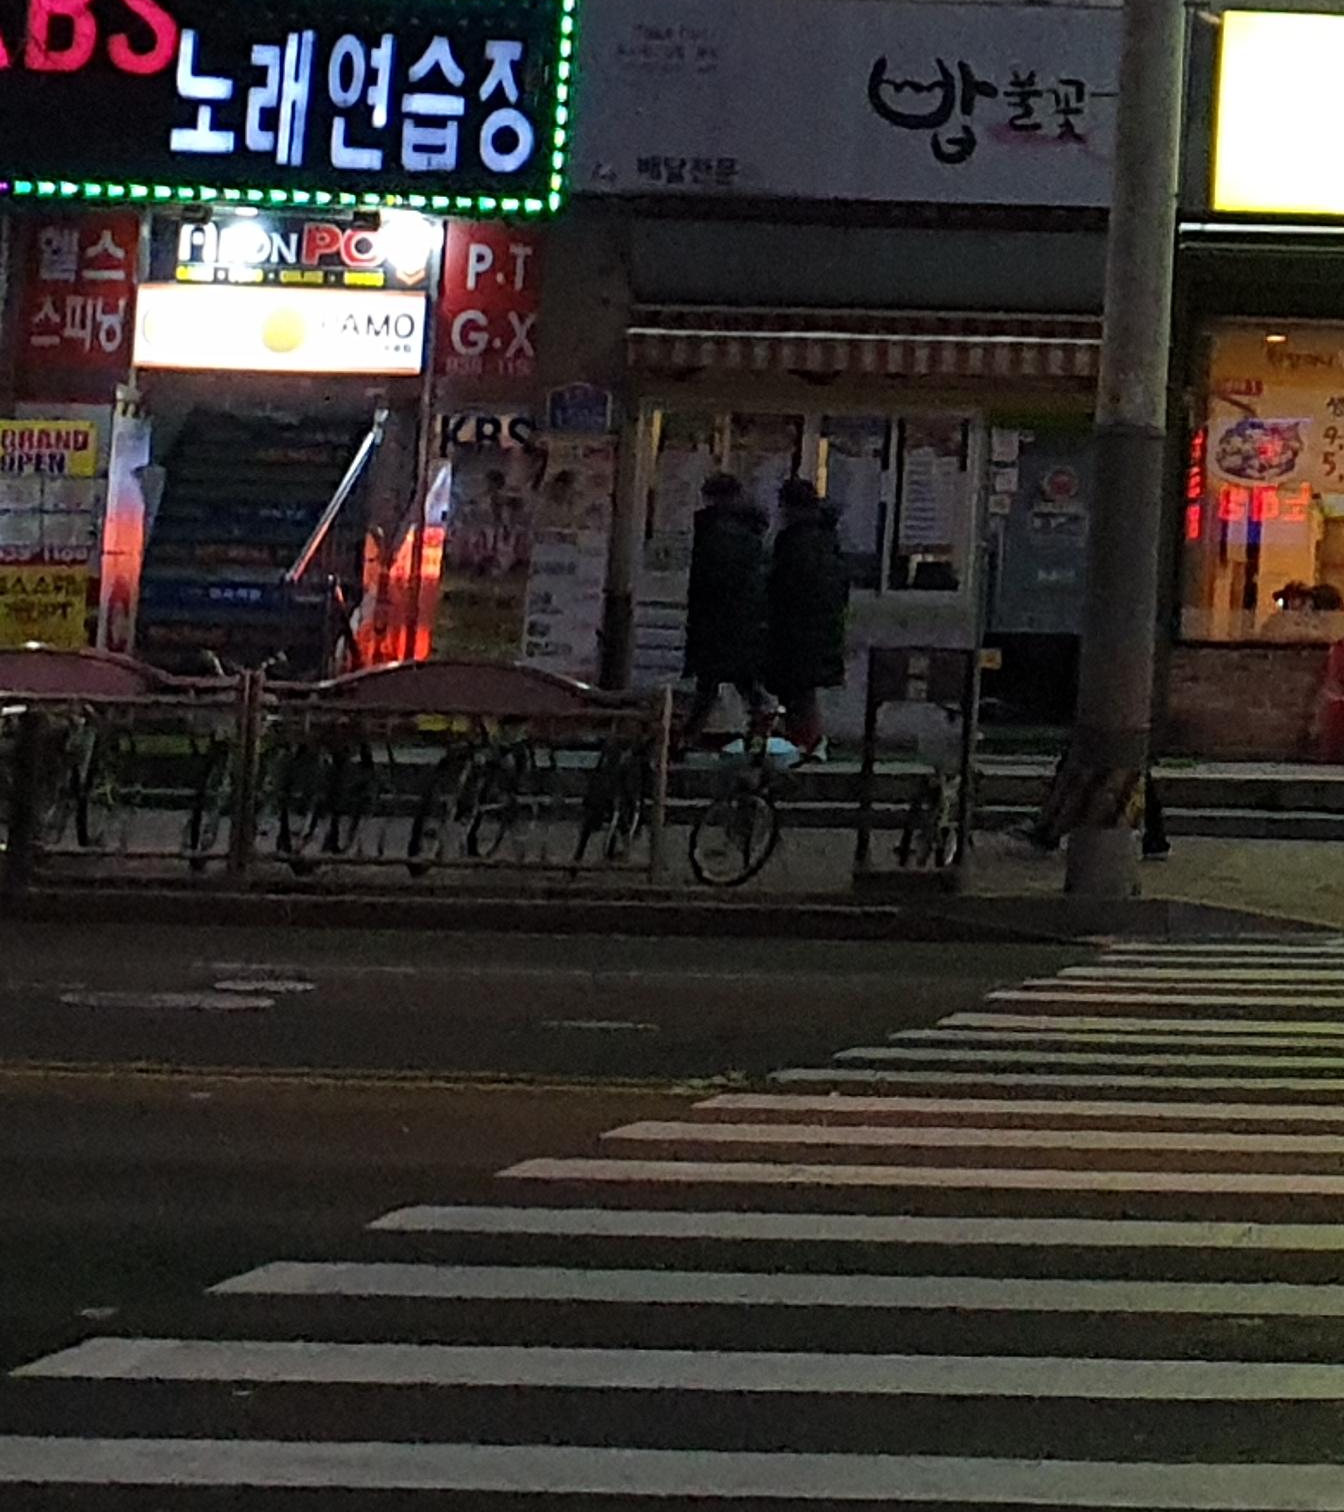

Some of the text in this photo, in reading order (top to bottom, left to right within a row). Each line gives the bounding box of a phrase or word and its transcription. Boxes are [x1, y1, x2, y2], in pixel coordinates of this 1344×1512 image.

[170, 28, 536, 174] 노래연습장
[38, 226, 125, 284] 헬스
[30, 295, 124, 354] 스피닝
